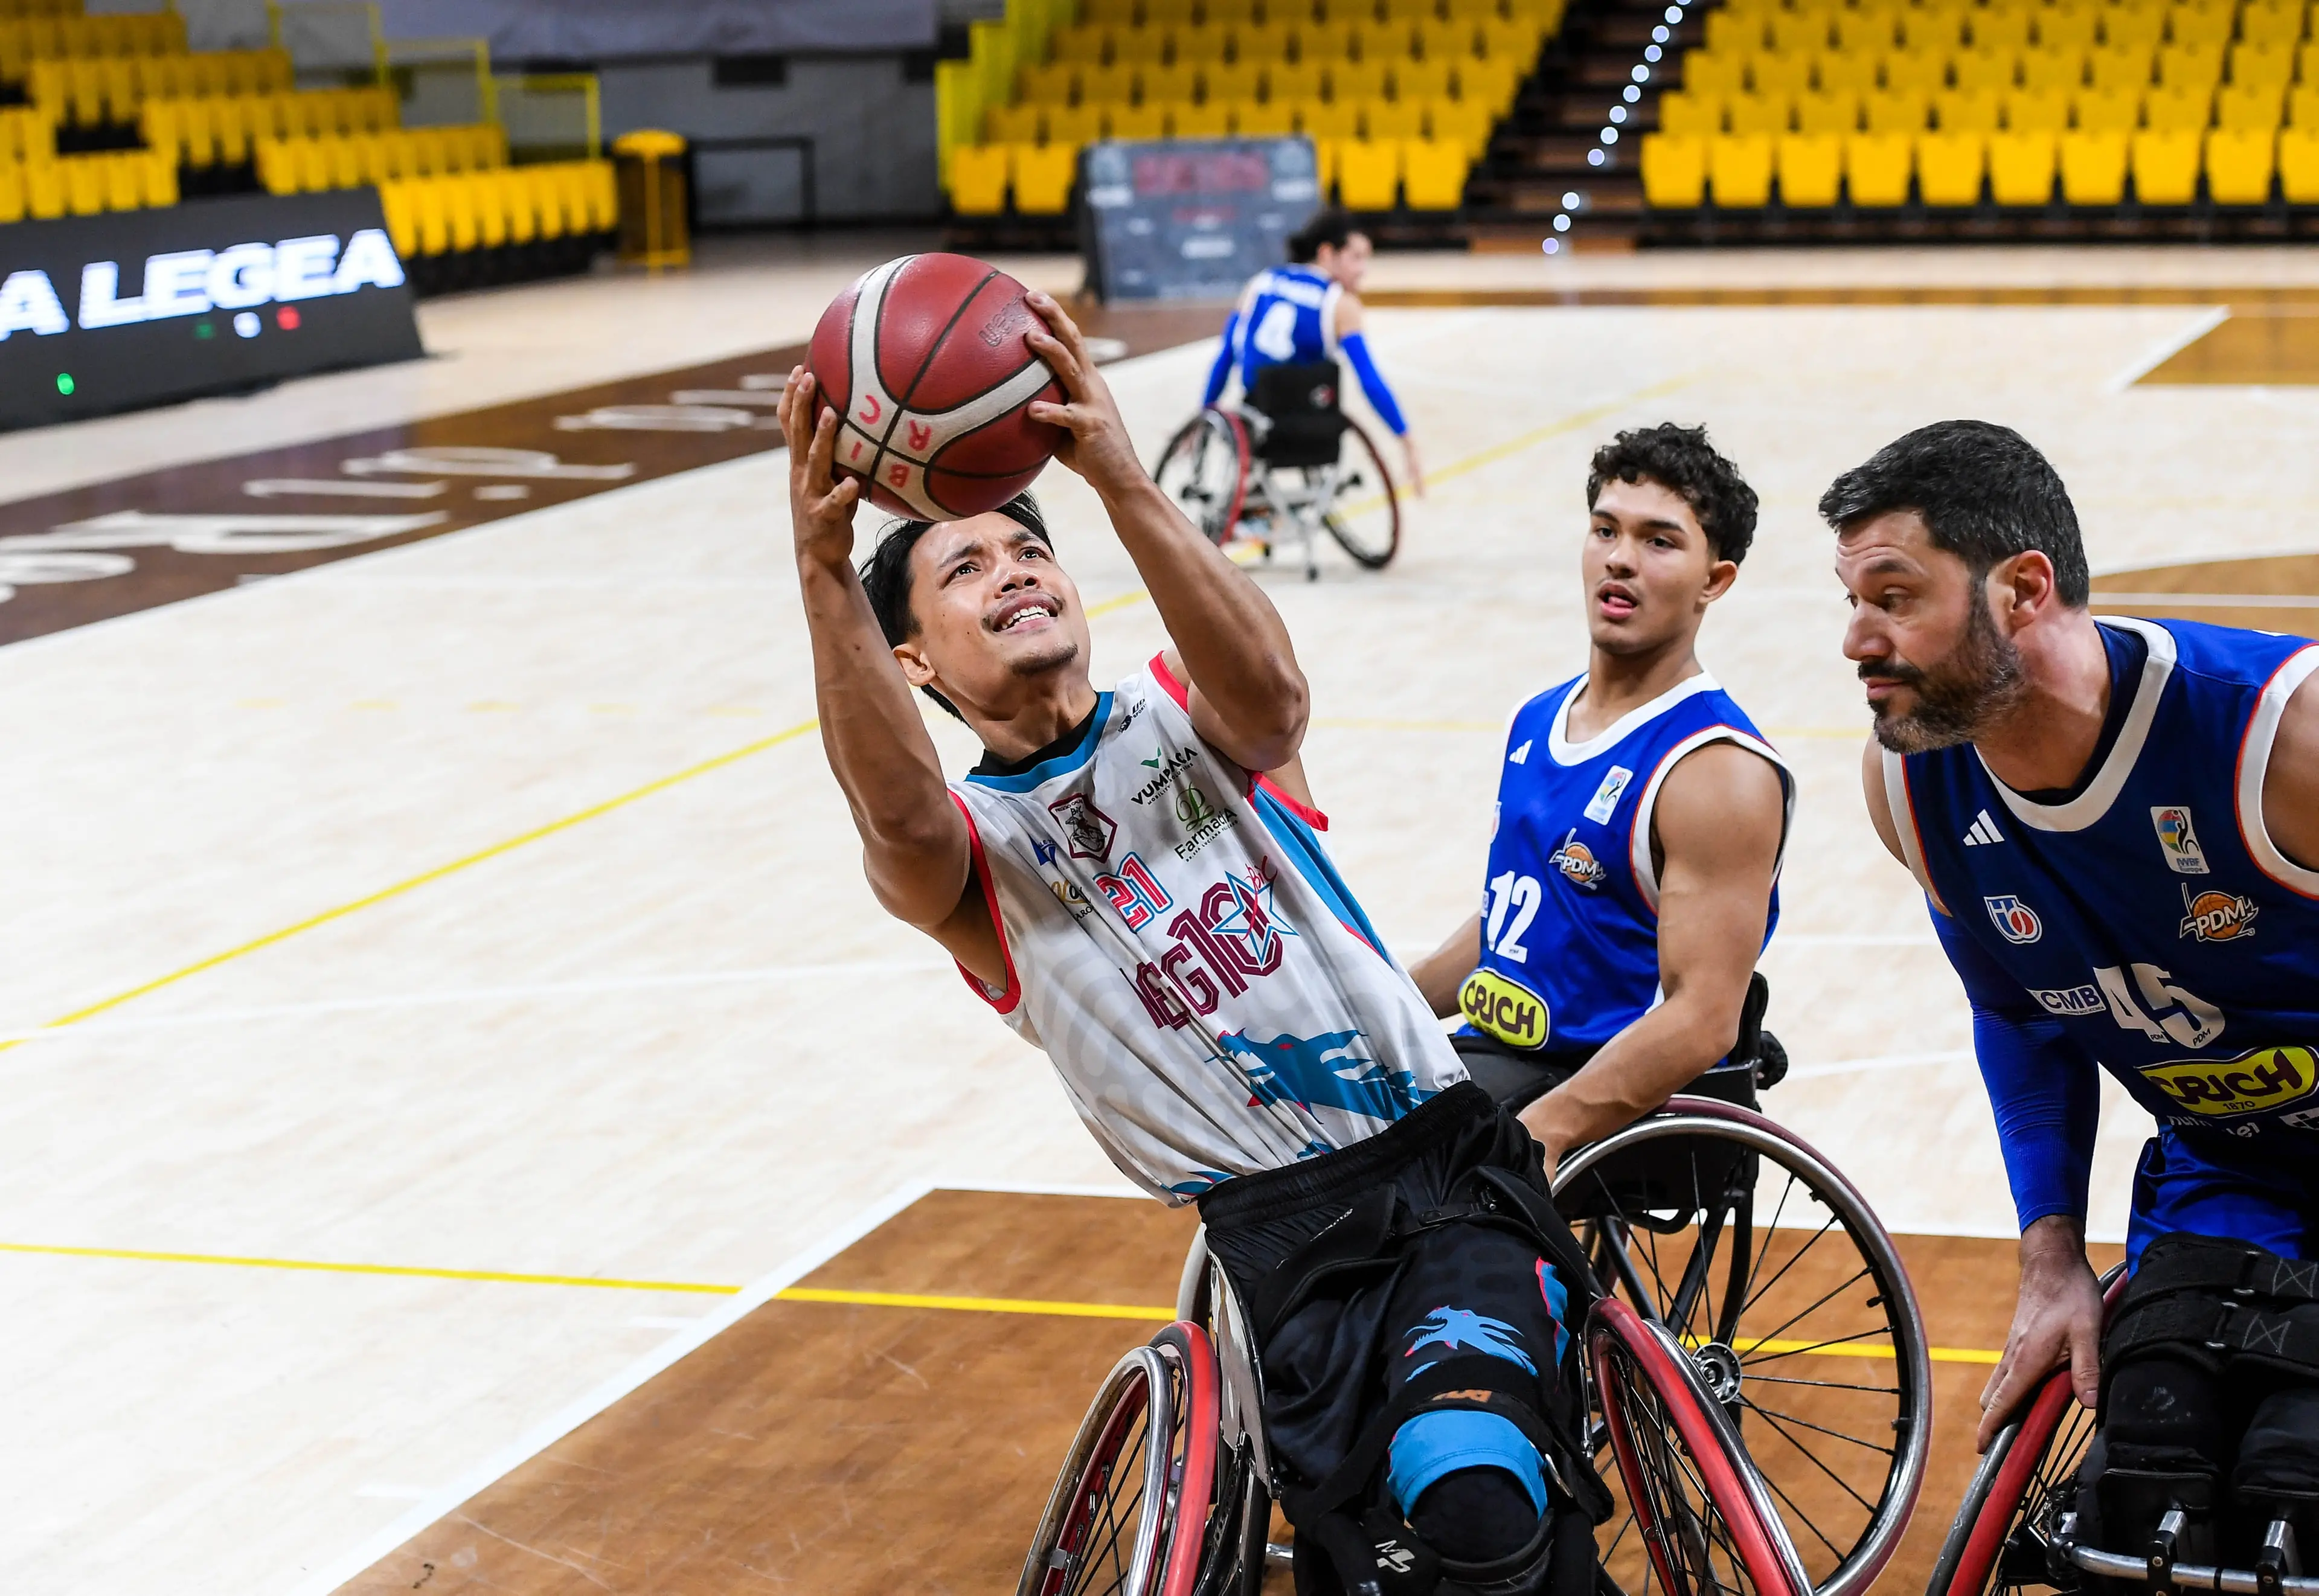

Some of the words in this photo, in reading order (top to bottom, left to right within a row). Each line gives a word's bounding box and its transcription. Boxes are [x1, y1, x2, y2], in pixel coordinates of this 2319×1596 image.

[79, 228, 405, 330] LEGEA
[1092, 851, 1173, 934] 21
[1563, 855, 1597, 876] PDM
[1487, 870, 1542, 964] 12
[2195, 899, 2246, 936] PDM
[1464, 979, 1536, 1039] CRICH
[2040, 987, 2100, 1010] CMB
[2093, 963, 2226, 1049] 45
[2192, 1028, 2212, 1046] PDM
[2149, 1049, 2303, 1104] CRICH
[2222, 1100, 2256, 1111] 1870
